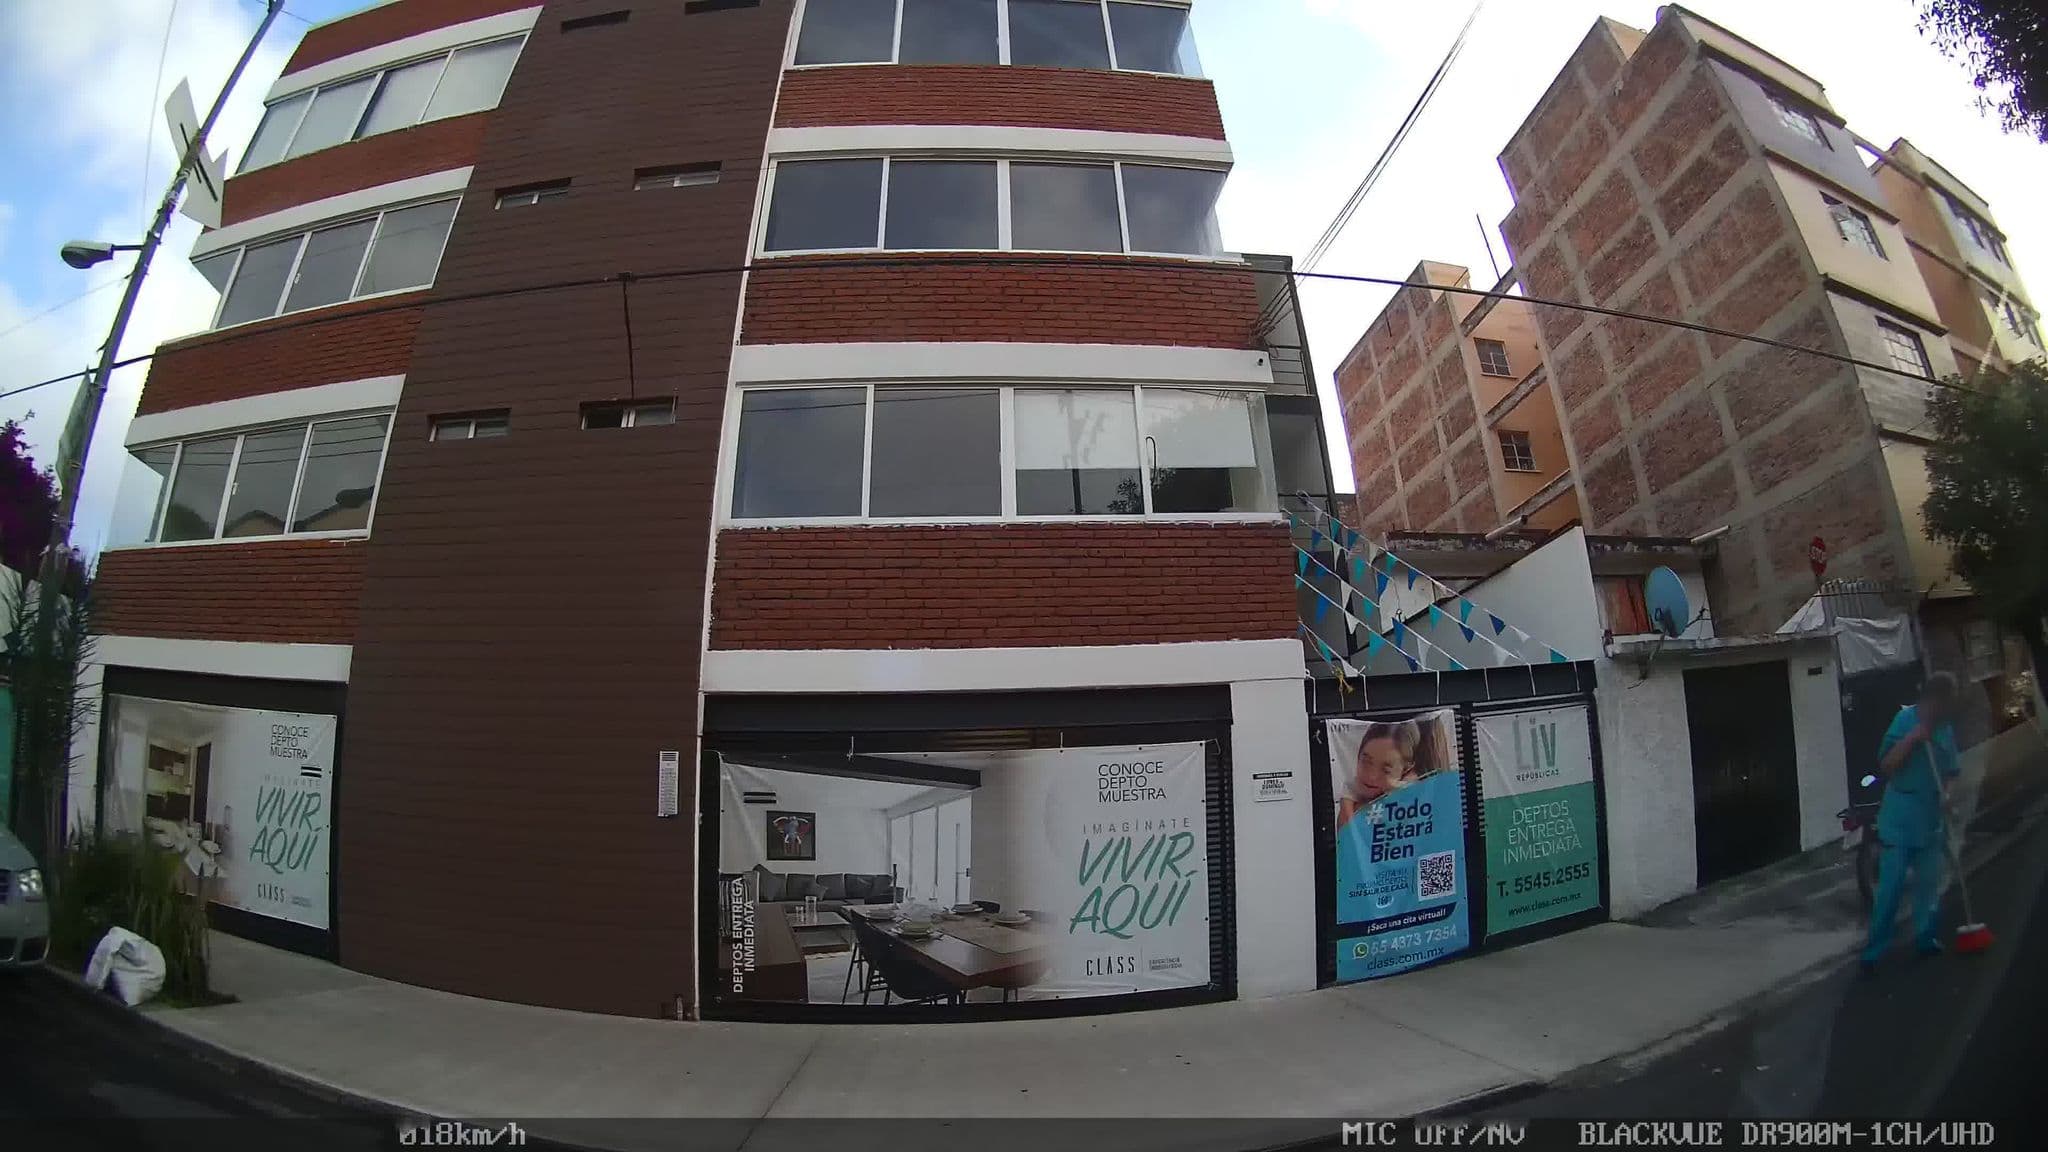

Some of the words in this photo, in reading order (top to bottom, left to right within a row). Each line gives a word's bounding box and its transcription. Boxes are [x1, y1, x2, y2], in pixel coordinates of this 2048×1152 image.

[271, 735, 298, 747] DEPTO
[272, 724, 309, 737] CONOCE
[270, 746, 308, 759] MUESTRA
[1098, 761, 1164, 776] CONOCE
[1099, 775, 1147, 790] DEPTO
[1099, 788, 1167, 802] MUESTRA
[256, 785, 321, 832] VIVIR
[1367, 798, 1432, 825] #Todo
[1513, 800, 1569, 825] DEPTOS
[1373, 815, 1433, 843] Estará
[1508, 818, 1576, 844] ENTREGA
[250, 826, 322, 874] AQUÍ
[1079, 831, 1195, 886] VIVIR
[1371, 843, 1414, 863] Bien
[1503, 834, 1582, 864] INMEDIATA
[1496, 881, 1509, 897] T.
[1514, 862, 1590, 894] 5545.2555
[732, 877, 744, 939] ENTREGA
[1069, 870, 1198, 940] AQUÍ
[1403, 915, 1417, 925] cita
[744, 900, 754, 971] INMEDIATA
[1391, 933, 1421, 950] 4373
[732, 942, 743, 993] DEPTOS
[1086, 956, 1135, 976] CLASS
[1368, 946, 1445, 970] class.com.mx
